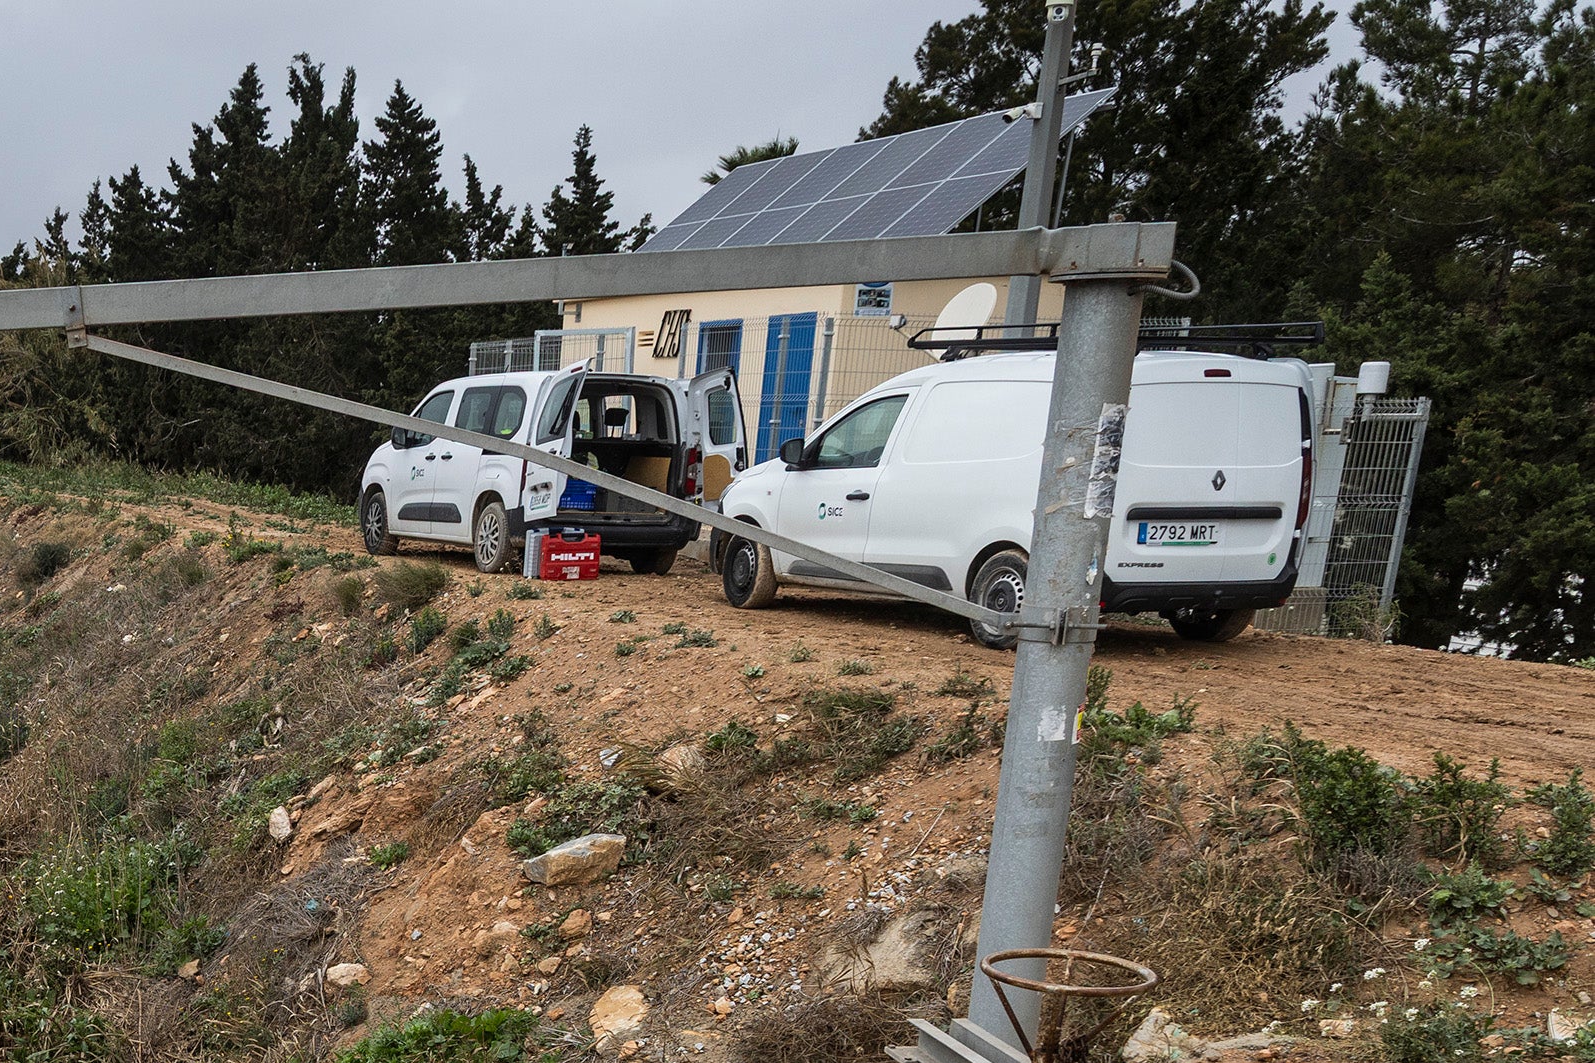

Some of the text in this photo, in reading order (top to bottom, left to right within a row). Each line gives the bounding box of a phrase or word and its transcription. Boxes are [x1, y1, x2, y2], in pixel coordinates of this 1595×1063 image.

[652, 308, 692, 358] CHS
[1149, 525, 1216, 540] 2792 MRT
[550, 552, 595, 561] HILTI
